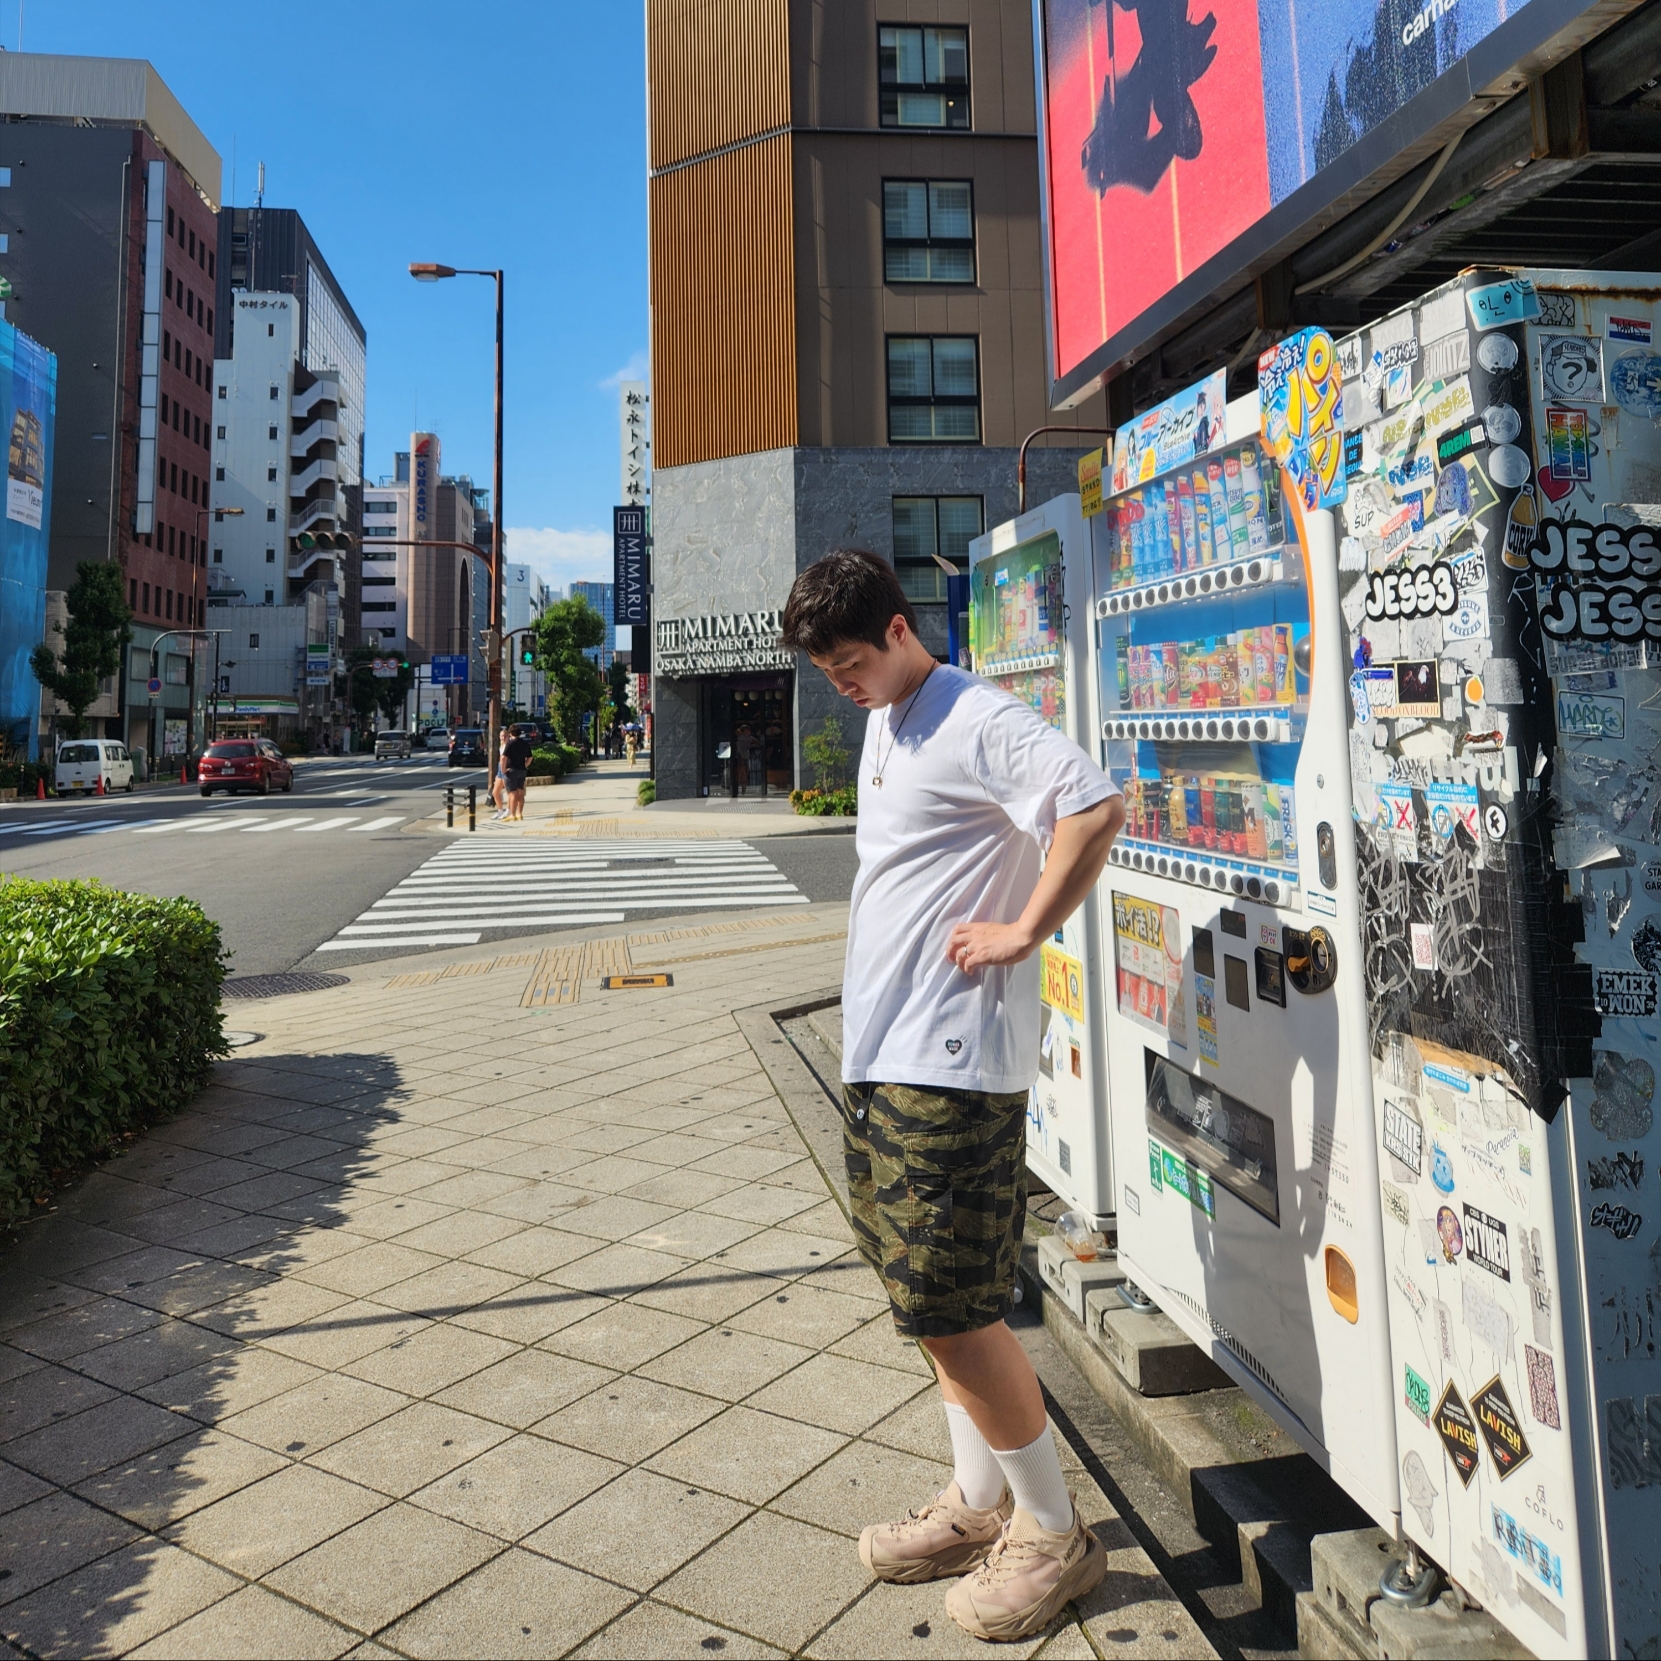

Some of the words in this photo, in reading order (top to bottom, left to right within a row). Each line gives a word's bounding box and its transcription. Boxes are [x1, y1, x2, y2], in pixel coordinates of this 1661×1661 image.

[239, 299, 289, 309] 中村タイル
[1260, 348, 1276, 368] NEW
[626, 389, 642, 506] 松永トイシ株
[1348, 449, 1358, 461] DE
[1354, 510, 1375, 529] SUP
[516, 570, 525, 582] 3
[618, 538, 626, 588] APARTMENT
[627, 536, 641, 620] MIMARU
[618, 590, 626, 619] HOTEL
[1366, 565, 1456, 619] JESS3
[685, 638, 749, 653] APARTMENT
[751, 636, 777, 649] HOT
[656, 658, 694, 671] OSAKA
[698, 655, 742, 668] NAMBA
[746, 652, 791, 665] NORTH
[1399, 704, 1439, 716] OXBLOOD
[1281, 800, 1293, 845] FRISK
[1048, 960, 1070, 1009] No.1
[1601, 973, 1654, 995] EMEK
[1385, 1102, 1421, 1155] STATE
[1473, 1253, 1490, 1271] WORLD
[1490, 1263, 1503, 1277] TOUR
[1440, 1416, 1478, 1450] LAVISH
[1480, 1403, 1521, 1451] LAVISH
